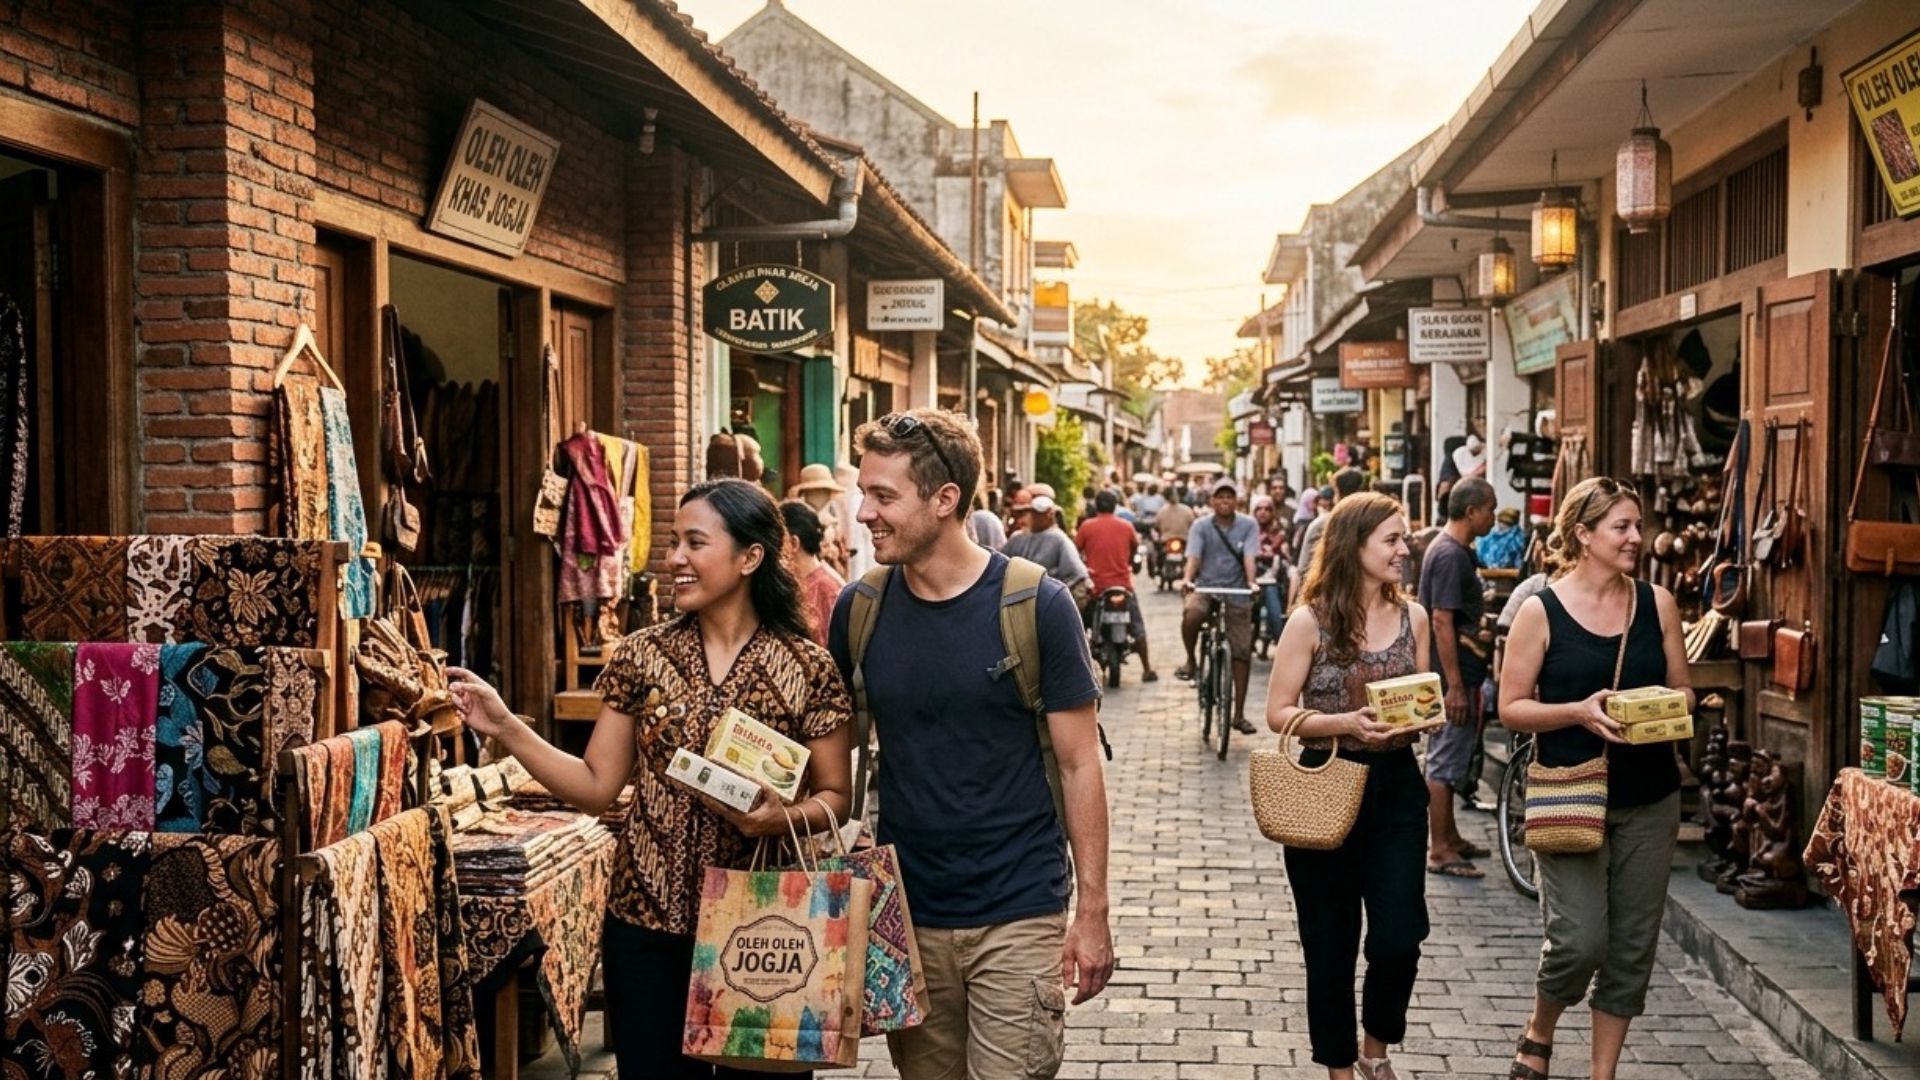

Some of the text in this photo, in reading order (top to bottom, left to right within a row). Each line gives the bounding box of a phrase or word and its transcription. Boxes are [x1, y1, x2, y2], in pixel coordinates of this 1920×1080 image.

[1858, 68, 1896, 111] OLEH
[464, 126, 547, 193] OLEH OLEH
[448, 174, 530, 234] KHAS JOGJA
[729, 308, 805, 330] BATIK
[736, 937, 805, 950] OLEH OLEH
[732, 951, 802, 974] JOGJA
